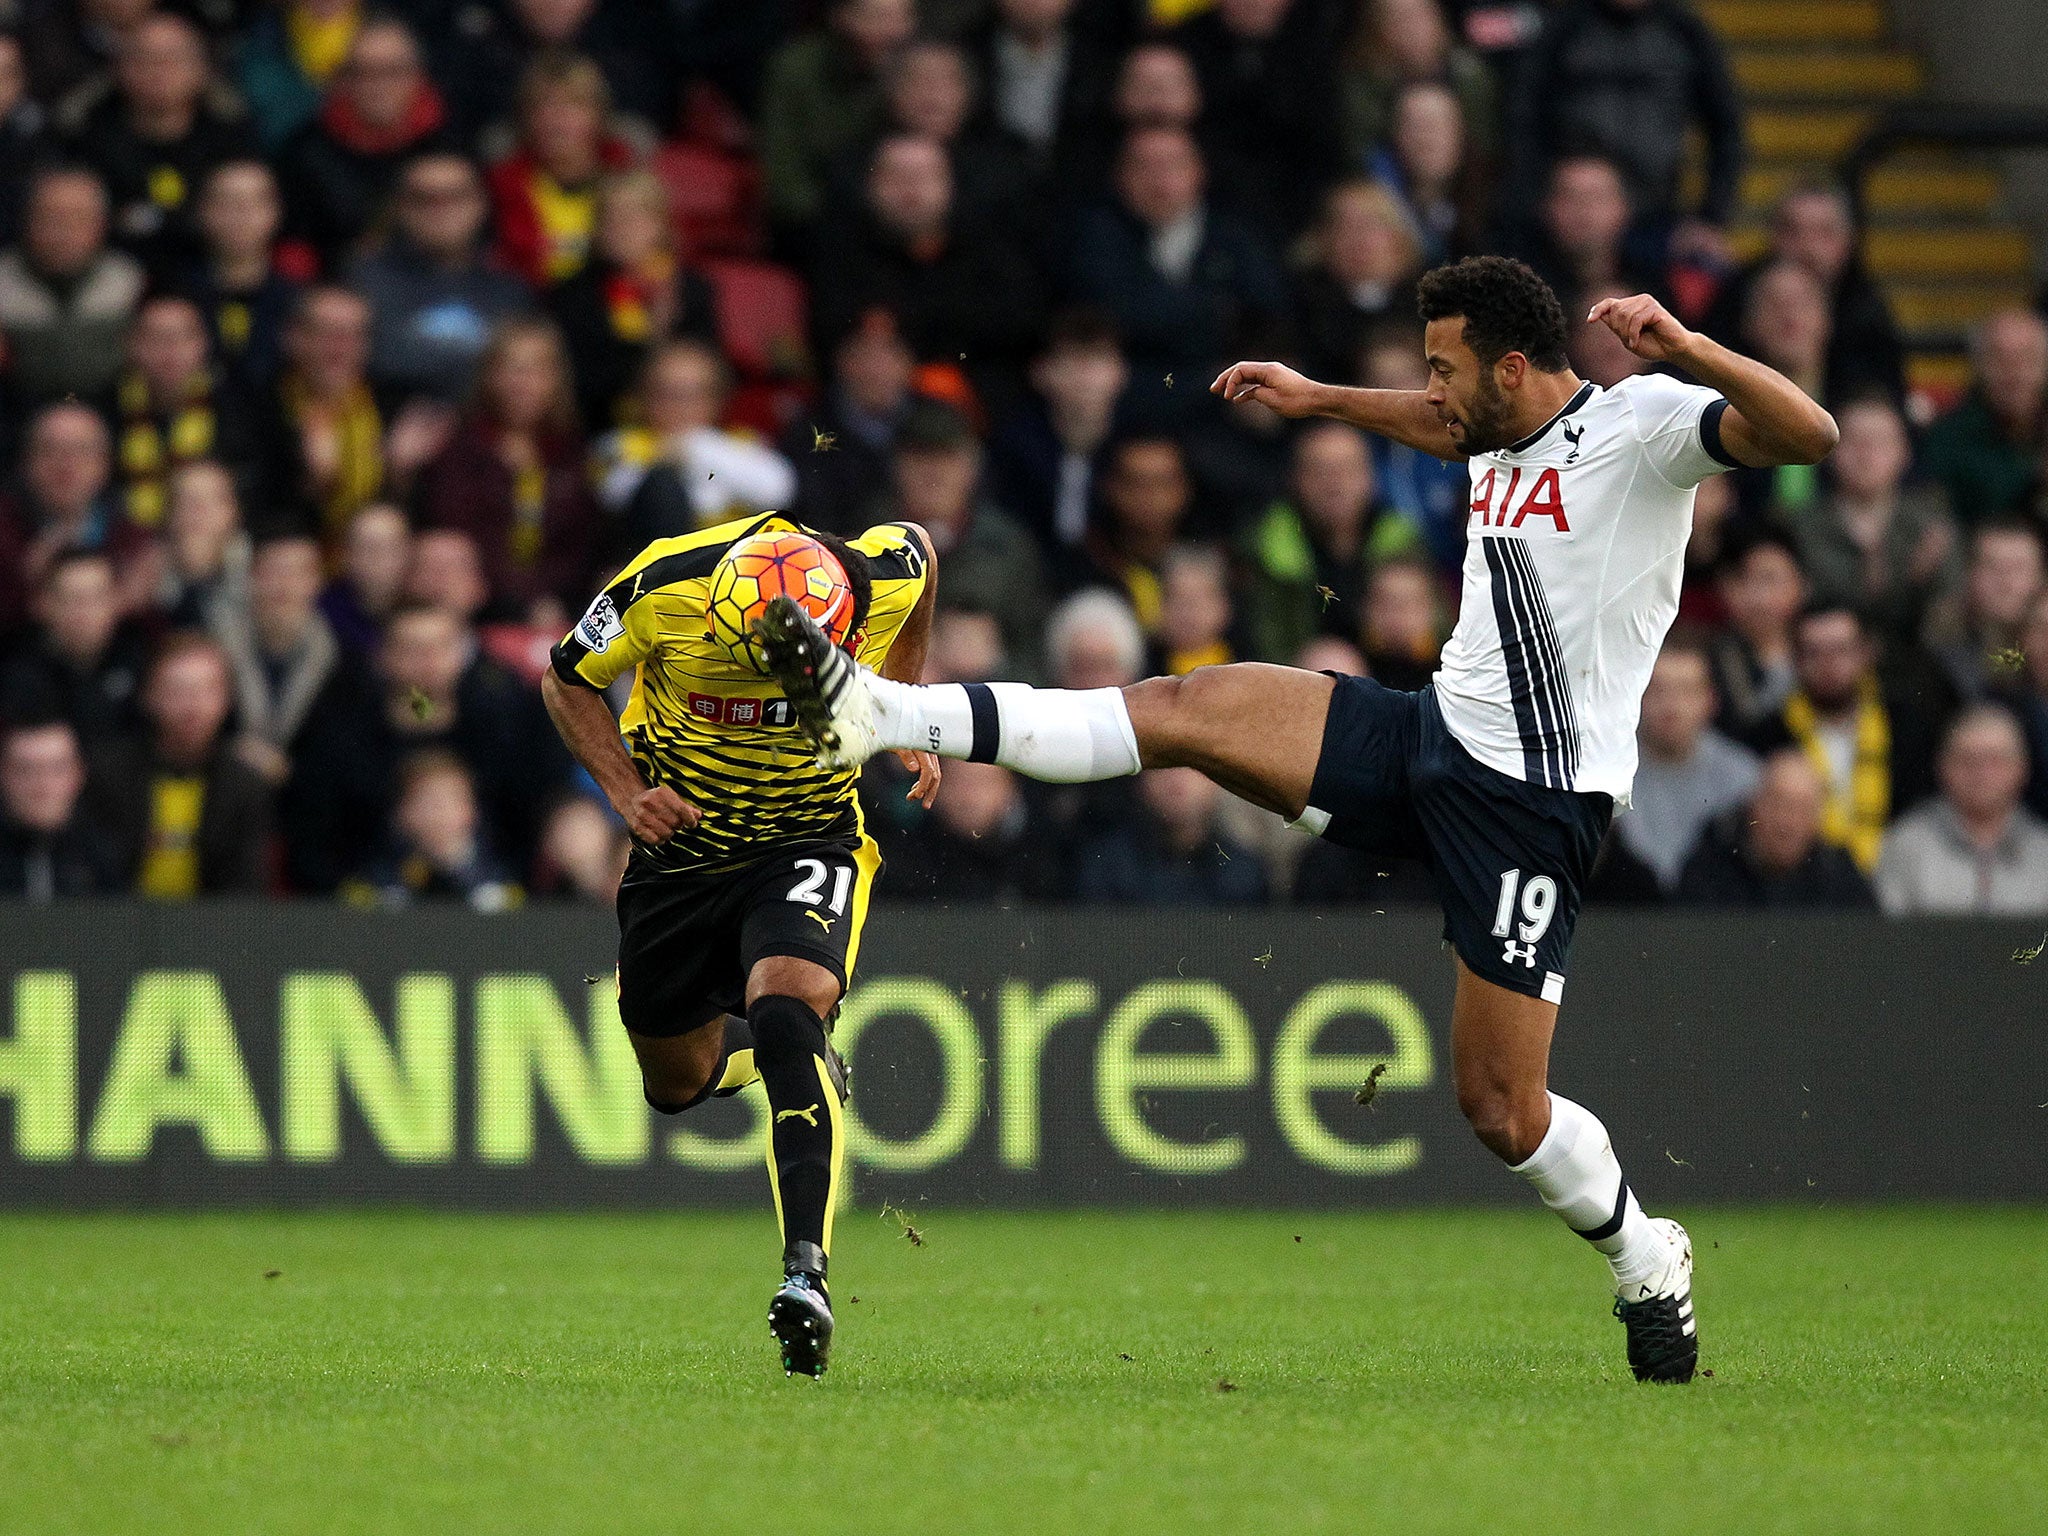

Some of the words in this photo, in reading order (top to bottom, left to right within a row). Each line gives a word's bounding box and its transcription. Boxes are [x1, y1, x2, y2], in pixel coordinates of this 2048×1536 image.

[1469, 467, 1571, 532] AIA
[786, 858, 852, 917] 21
[1491, 868, 1558, 944] 19
